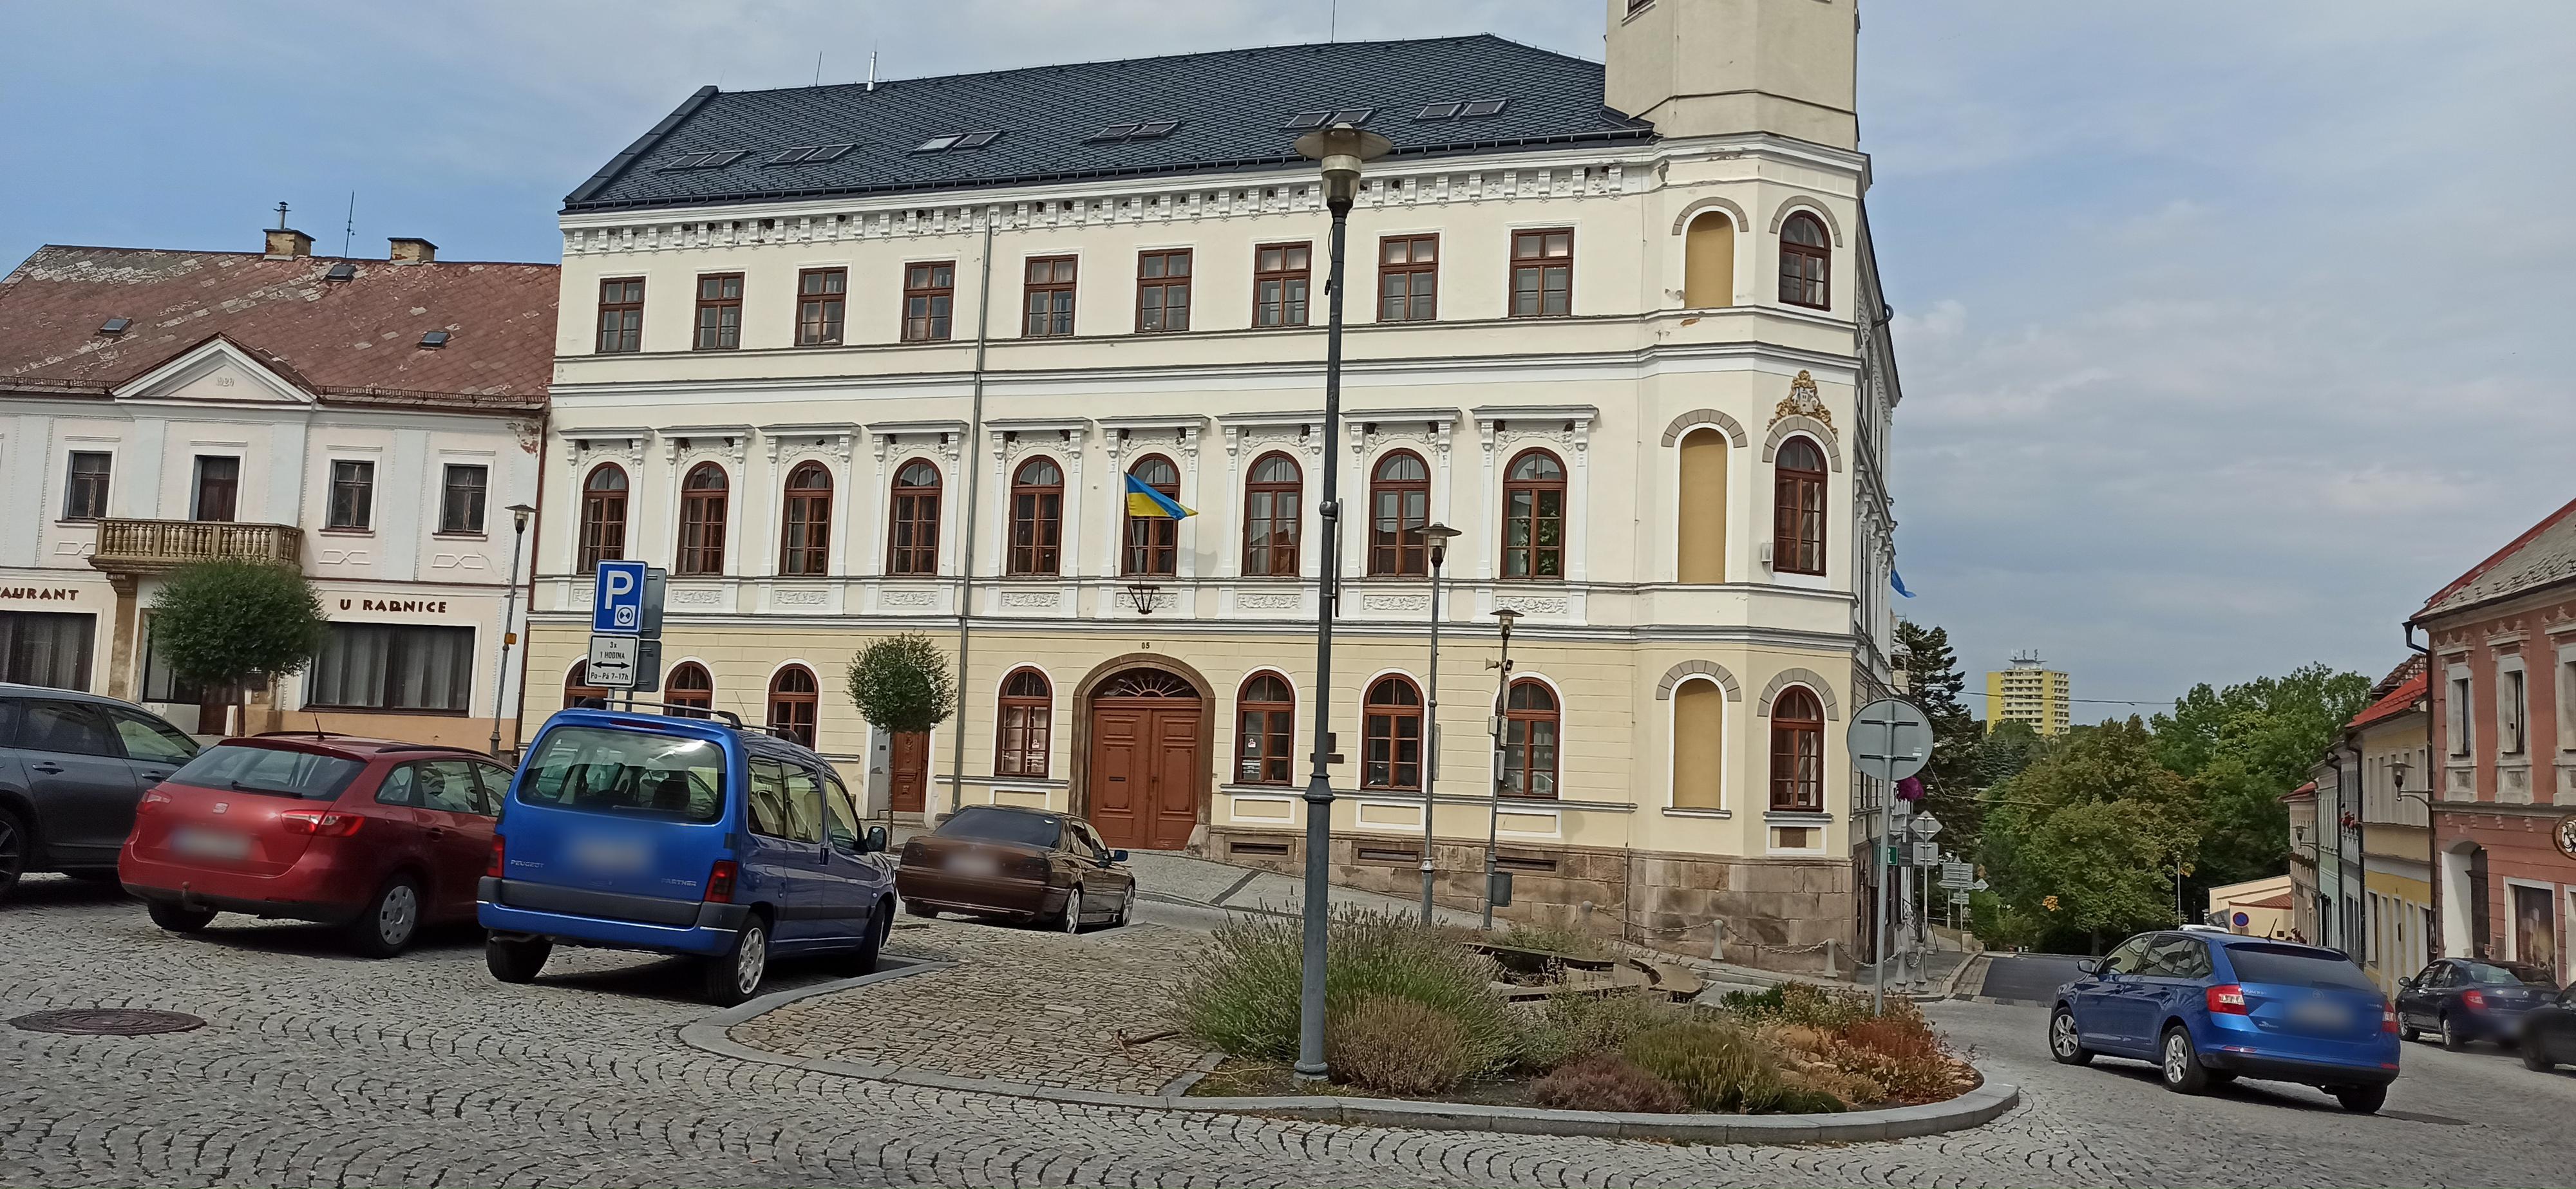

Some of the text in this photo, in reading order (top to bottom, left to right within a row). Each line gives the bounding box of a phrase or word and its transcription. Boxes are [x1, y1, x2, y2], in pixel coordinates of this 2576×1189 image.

[0, 586, 79, 601] AURANT
[605, 570, 634, 610] P
[340, 599, 447, 613] U RADNICE
[604, 651, 625, 660] HODINA
[510, 859, 545, 868] PEUGEOT
